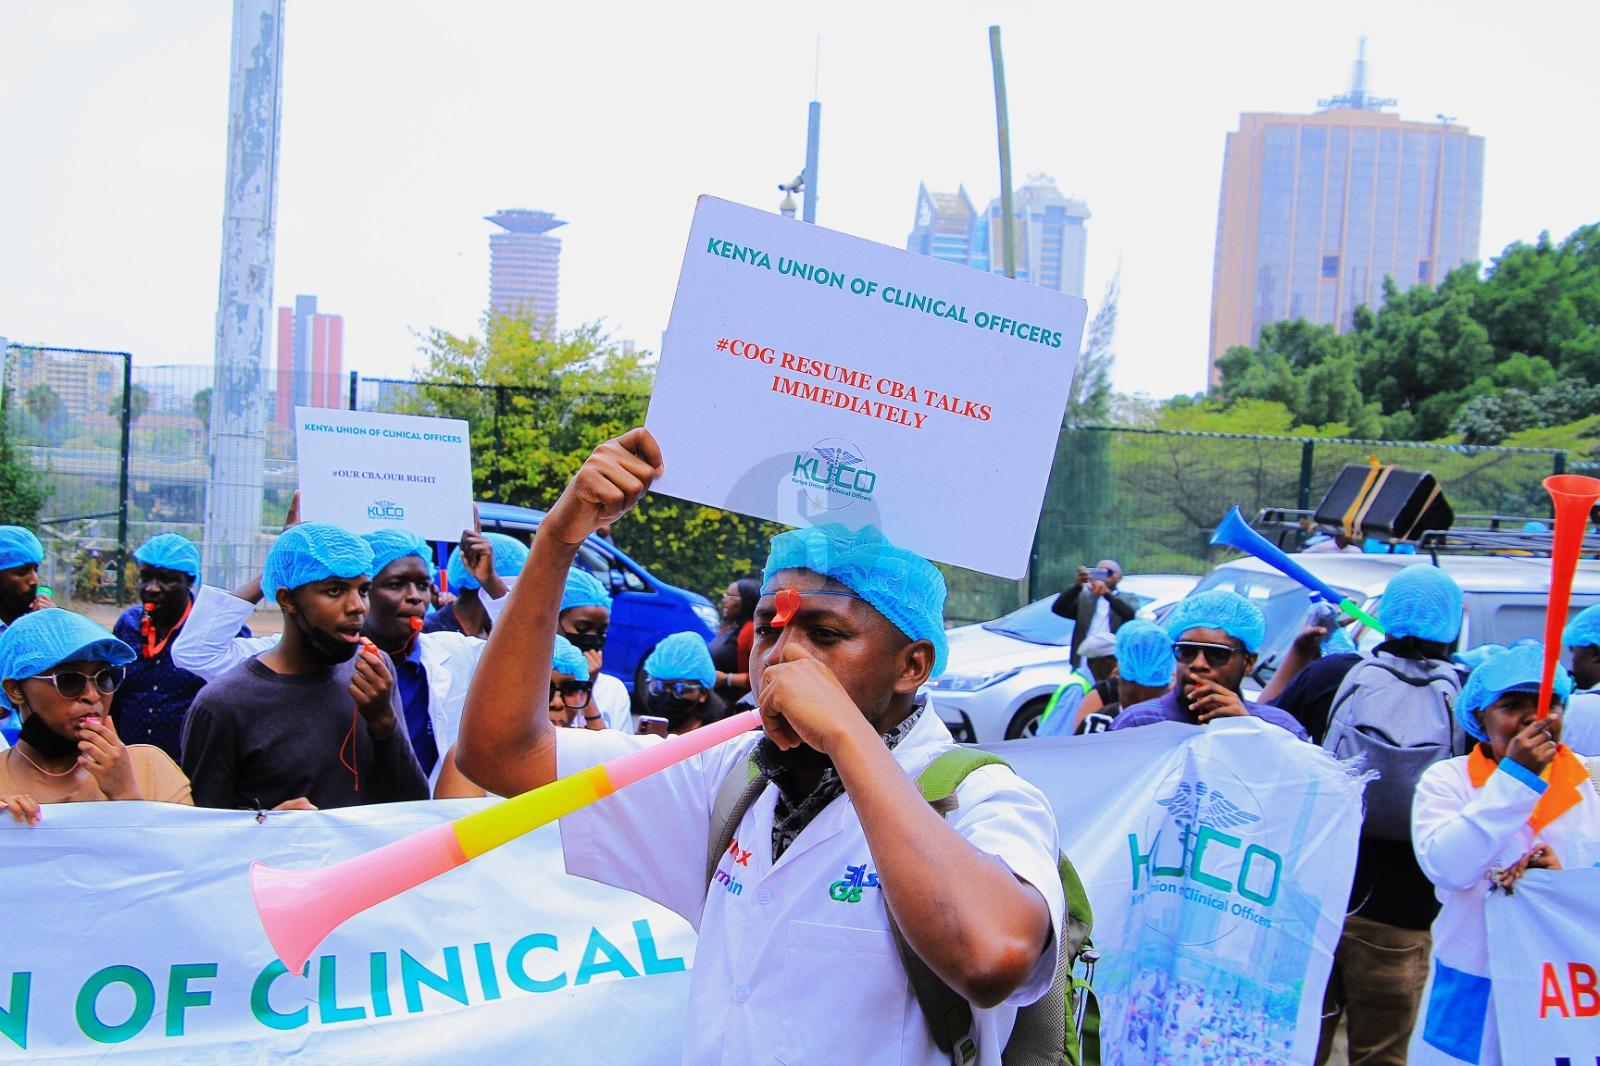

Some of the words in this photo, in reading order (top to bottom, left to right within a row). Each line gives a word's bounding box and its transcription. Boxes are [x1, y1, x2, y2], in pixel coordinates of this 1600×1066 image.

[706, 237, 771, 270] KENYA
[778, 257, 846, 289] UNION
[850, 277, 878, 297] OF
[882, 286, 969, 324] CLINICAL
[974, 311, 1062, 349] OFFICERS
[716, 338, 776, 365] #COG
[780, 352, 872, 391] RESUME
[876, 378, 919, 404] CBA
[924, 389, 992, 421] TALKS
[770, 375, 928, 429] IMMEDIATELY
[304, 423, 334, 433] KENYA
[336, 426, 367, 436] UNION
[369, 428, 381, 437] OF
[383, 430, 421, 440] CLINICAL
[423, 433, 462, 444] OFFICERS
[332, 470, 360, 479] #OUR
[406, 475, 437, 484] RIGHT
[793, 455, 877, 494] KUCO
[367, 506, 404, 517] KUCO
[75, 962, 218, 1044] OF
[250, 918, 686, 1030] CLINICAL
